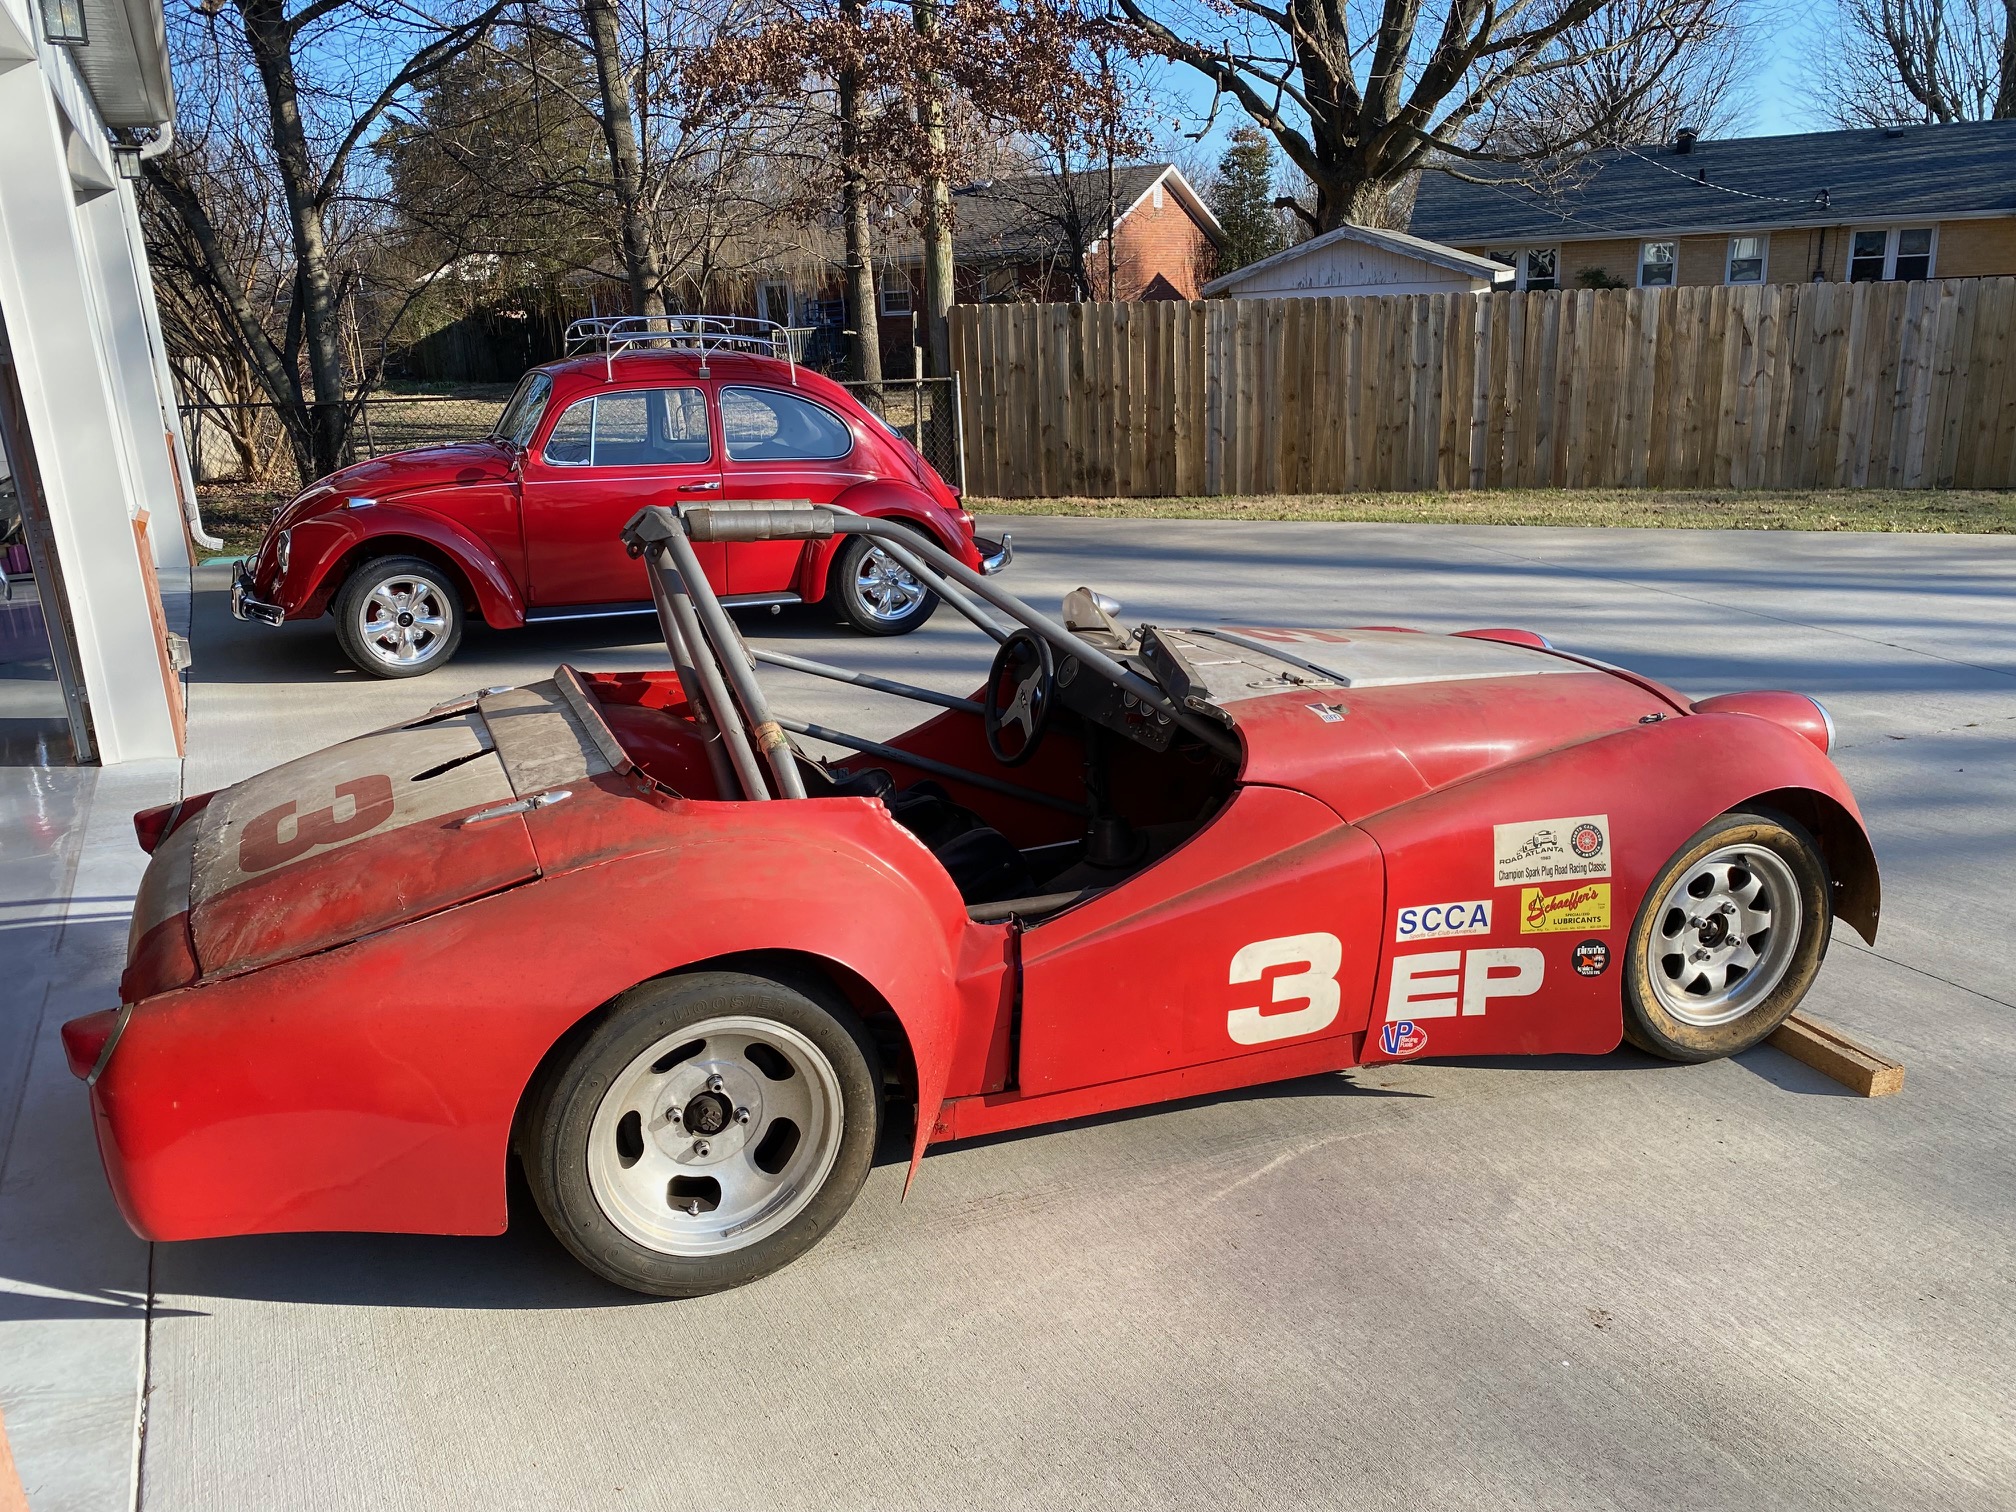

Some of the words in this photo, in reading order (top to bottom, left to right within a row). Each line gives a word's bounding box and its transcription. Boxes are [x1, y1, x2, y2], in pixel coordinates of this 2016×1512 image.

[239, 774, 394, 873] 3
[1499, 854, 1523, 865] ROAD
[1525, 847, 1564, 858] ATLANTA
[1498, 869, 1524, 881] Champion
[1525, 867, 1540, 880] Spark
[1541, 866, 1553, 878] Plug
[1555, 865, 1568, 875] Road
[1569, 863, 1587, 875] Racing
[1588, 862, 1606, 872] Classic
[1399, 904, 1488, 934] SCCA
[1527, 887, 1598, 921] Schaeffer's
[1553, 916, 1602, 925] LUBRICANTS
[1577, 945, 1605, 957] piranha
[1227, 932, 1342, 1045] 3
[1385, 947, 1545, 1022] EP
[672, 995, 788, 1021] HOOSIER
[1382, 1020, 1415, 1054] VP
